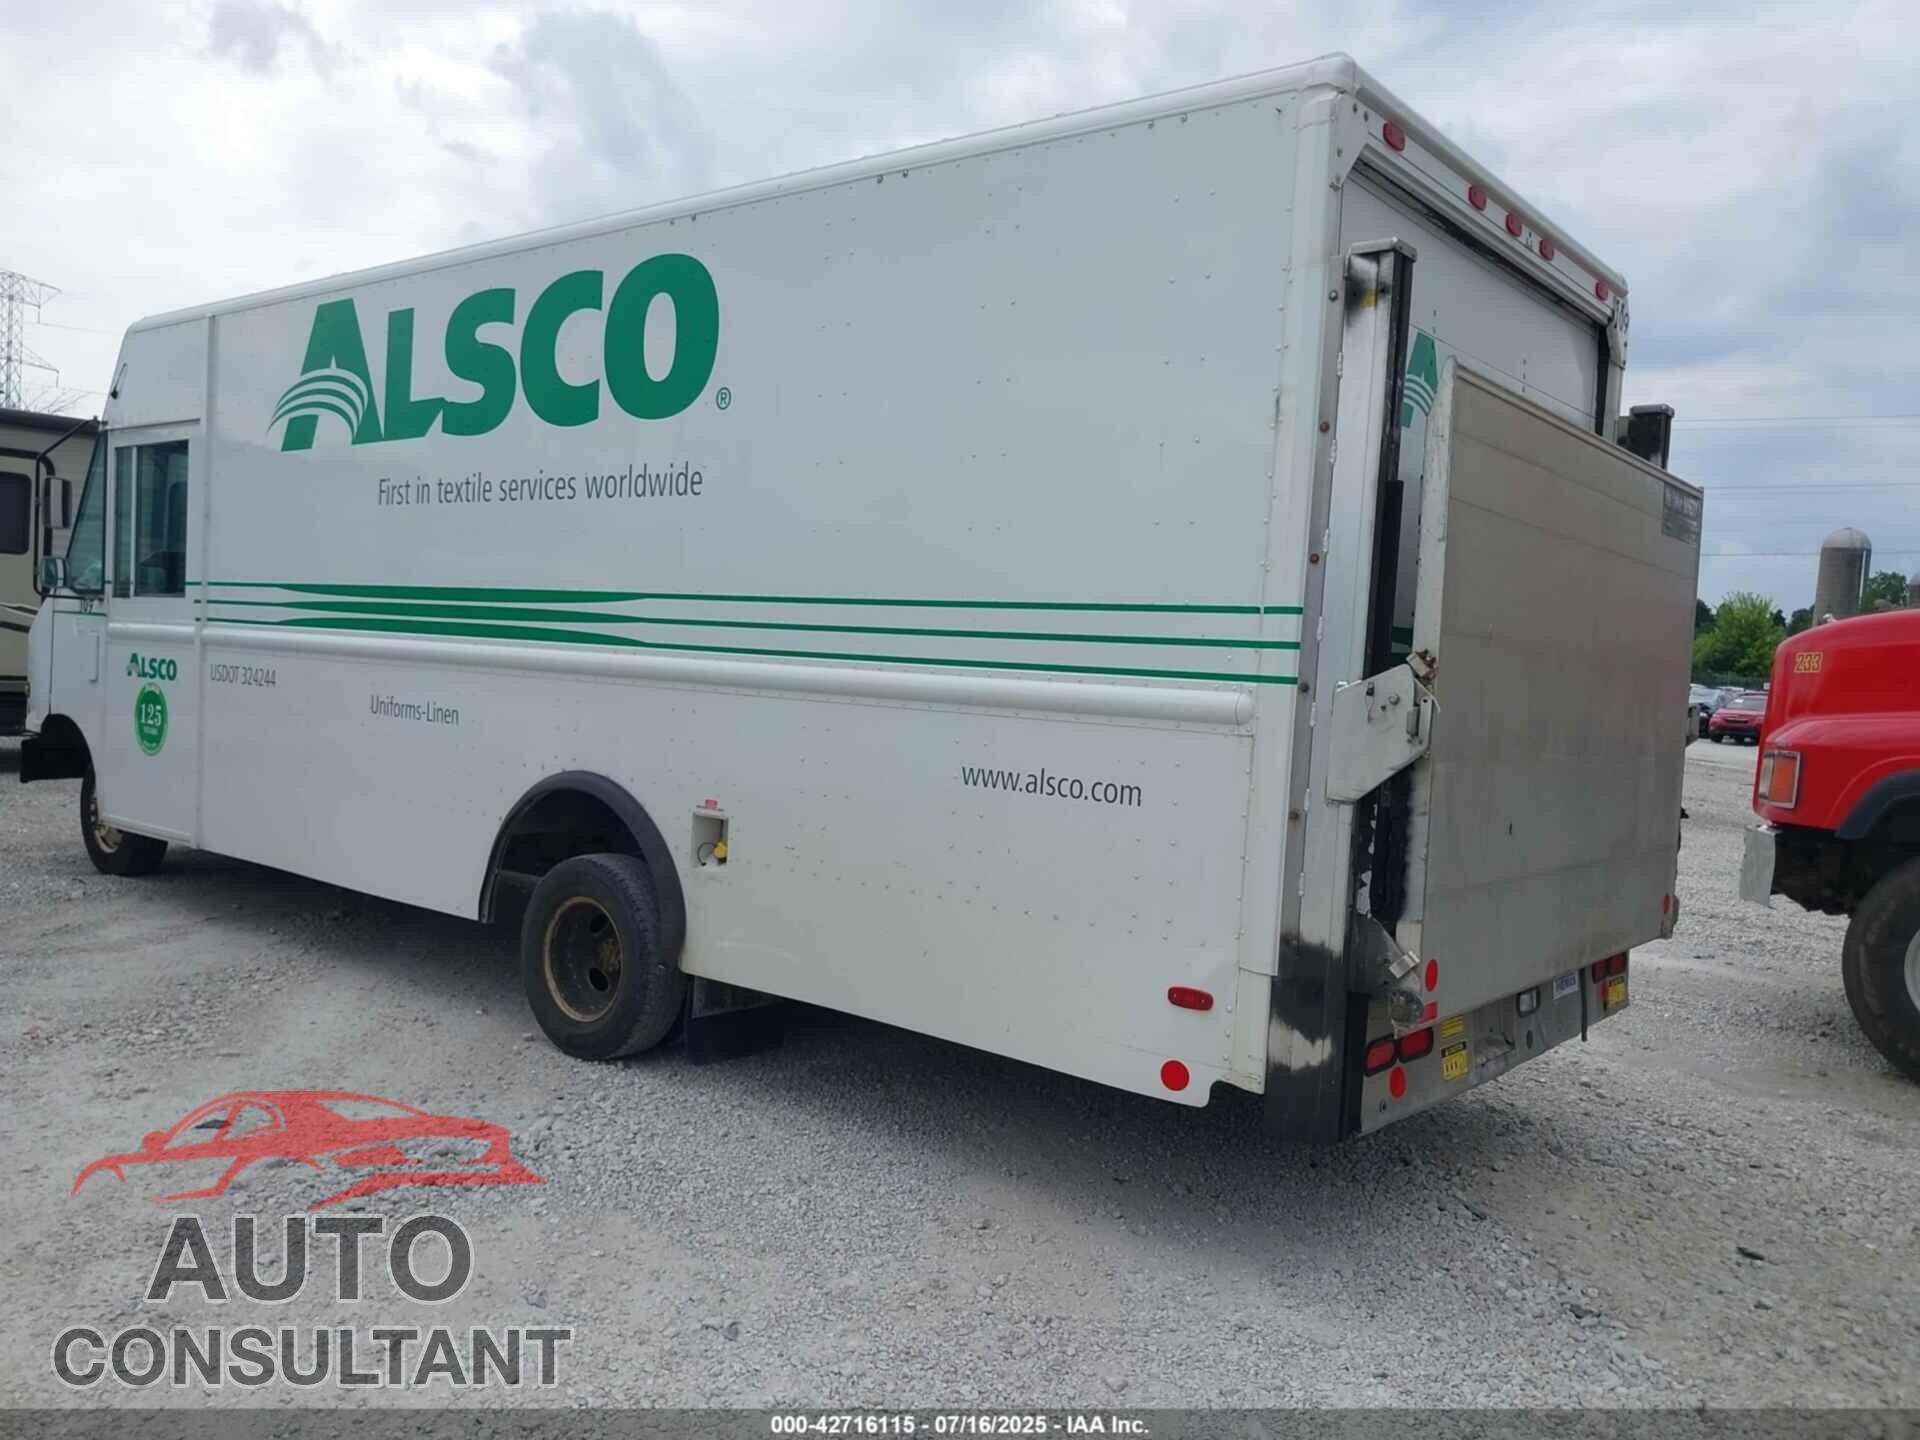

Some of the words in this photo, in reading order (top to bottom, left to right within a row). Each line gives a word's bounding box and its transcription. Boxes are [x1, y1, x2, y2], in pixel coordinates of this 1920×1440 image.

[266, 253, 720, 453] ALSCO
[377, 477, 412, 506] First
[416, 475, 431, 505] in
[437, 472, 493, 504] textile
[498, 469, 578, 502] services
[584, 461, 704, 500] worldwide
[126, 652, 178, 681] ALSCO
[209, 663, 240, 684] USDOT
[241, 667, 277, 688] 324244
[140, 703, 162, 726] 125
[369, 694, 460, 727] Uniforms-Linen
[961, 766, 1142, 807] www.alsco.com
